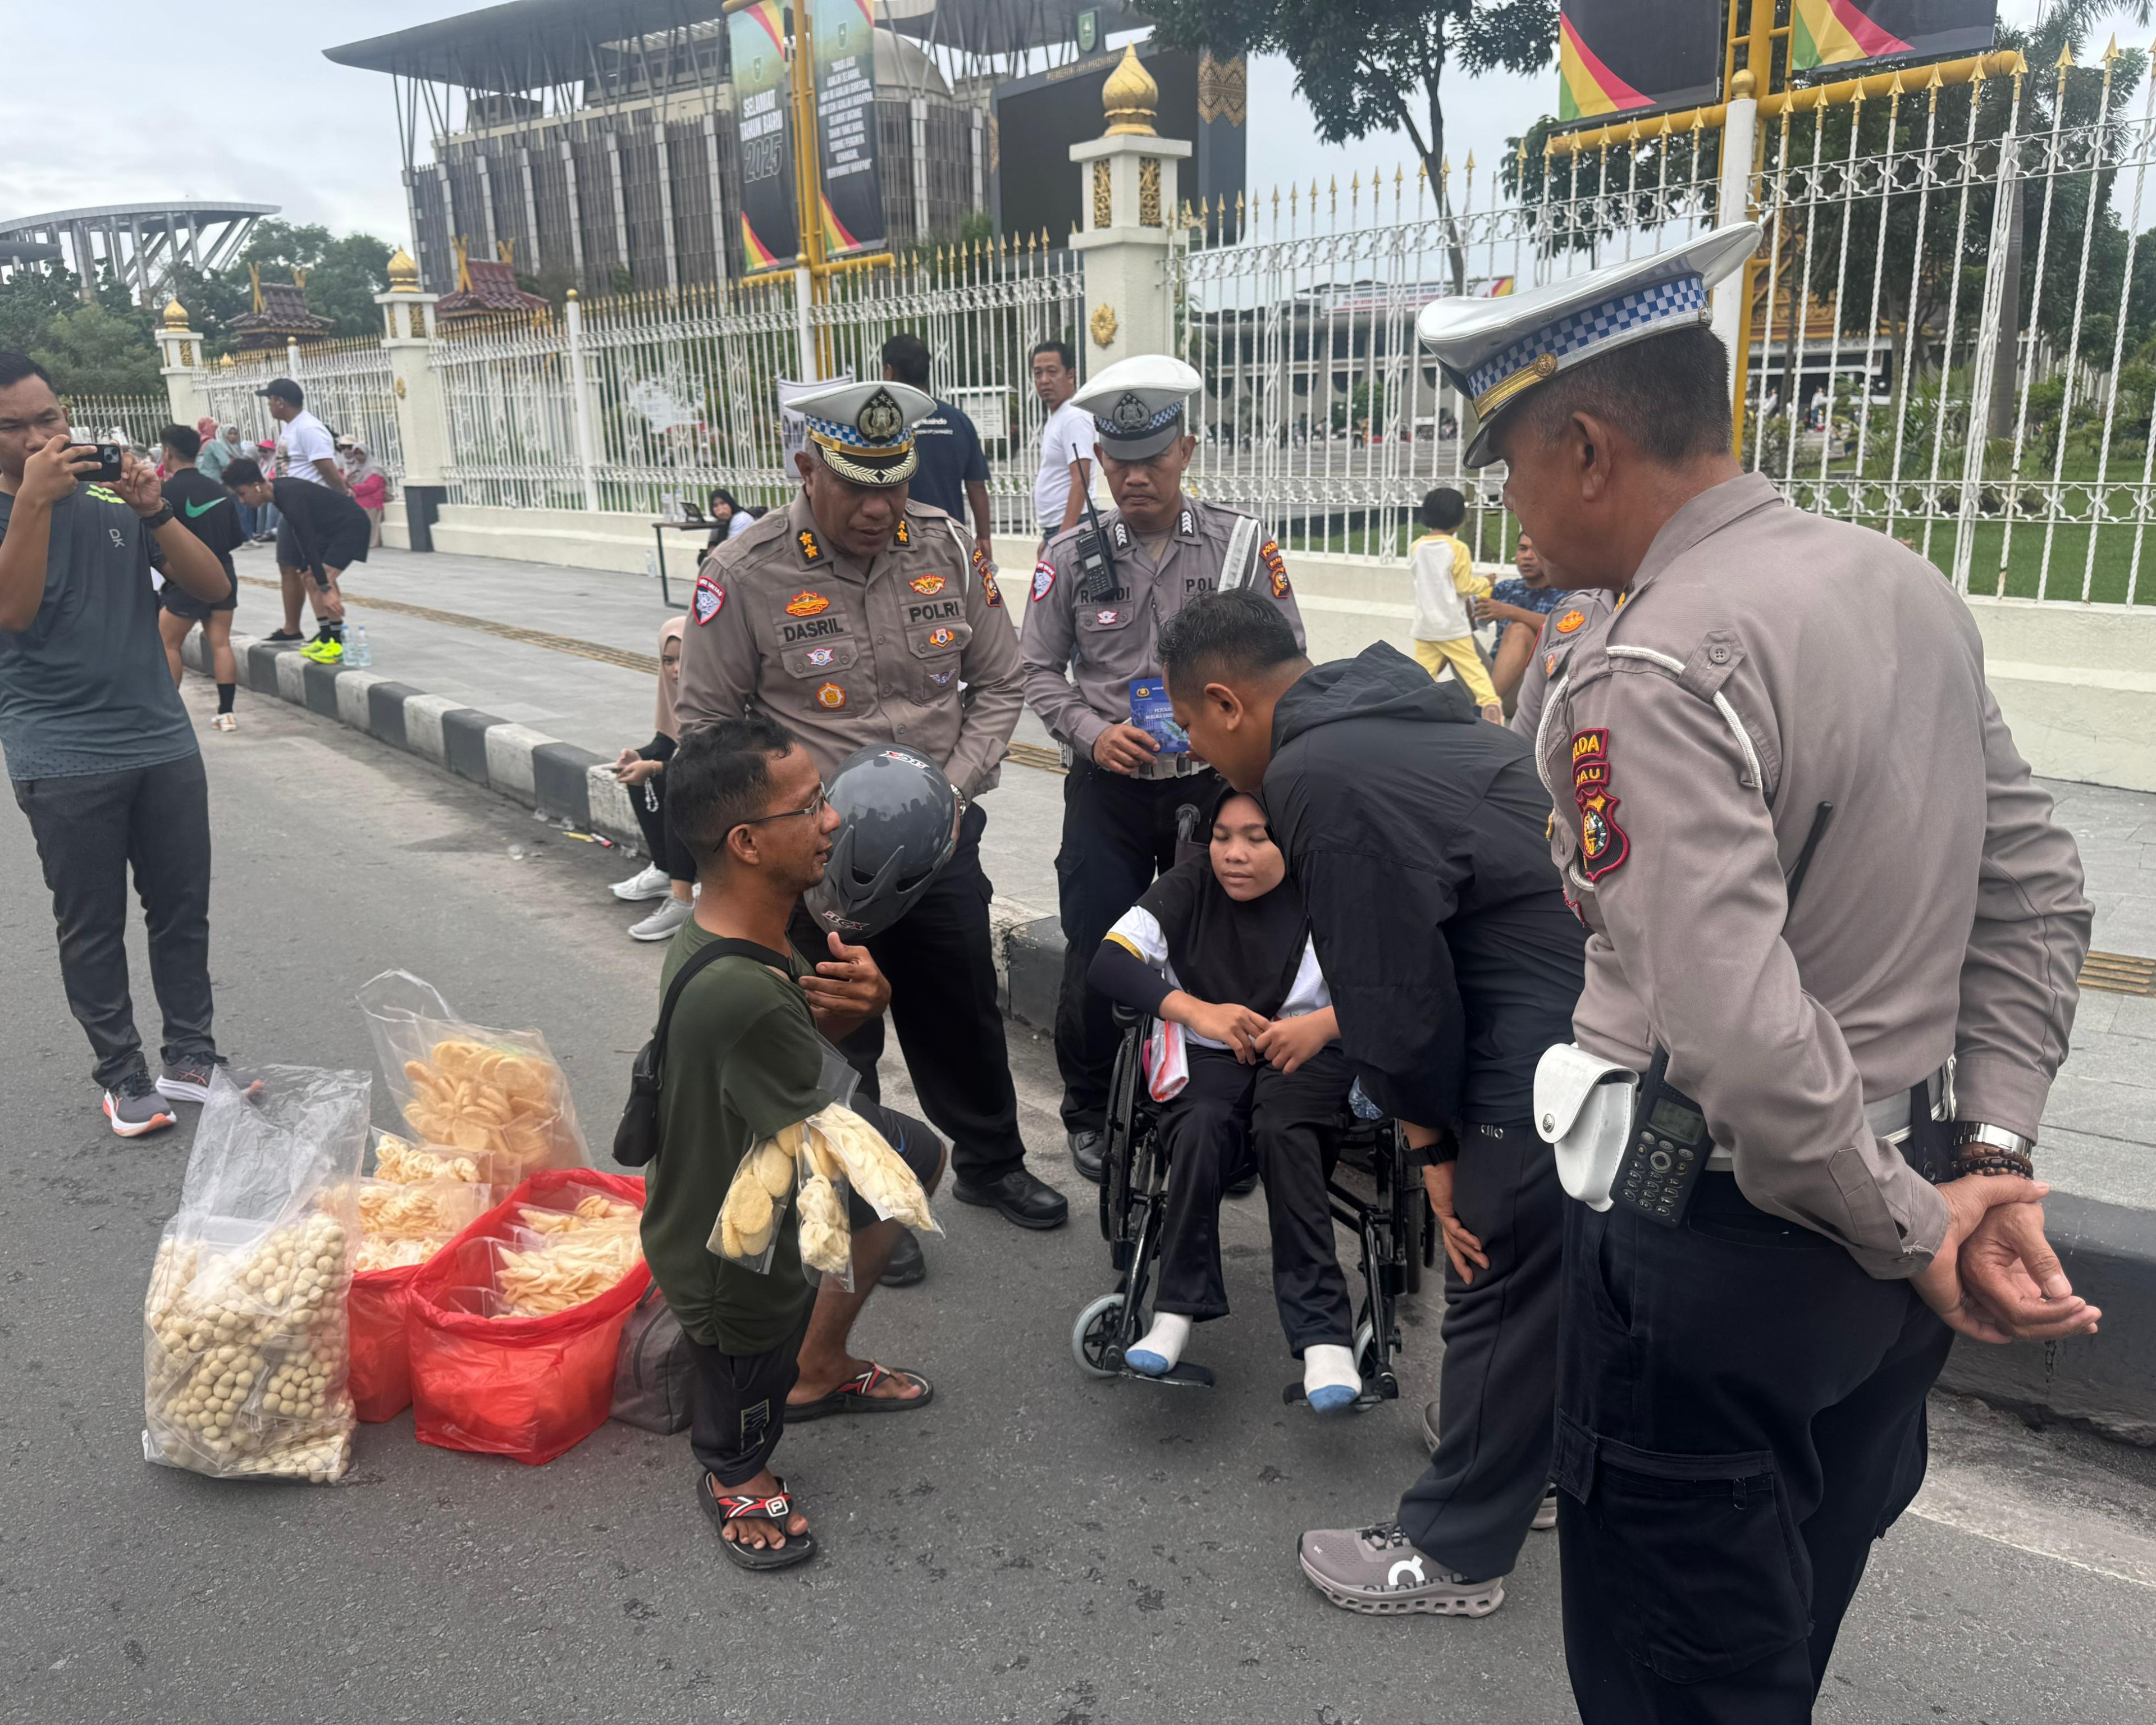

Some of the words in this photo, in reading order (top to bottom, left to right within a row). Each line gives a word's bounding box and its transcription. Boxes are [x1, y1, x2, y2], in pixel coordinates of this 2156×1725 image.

[743, 89, 776, 118] SELAMAT
[739, 116, 762, 142] TAHUN
[763, 109, 783, 135] BARU
[744, 133, 783, 183] 2025
[908, 601, 960, 623] POLRI
[783, 618, 844, 642] DASRIL
[1573, 734, 1600, 762] LDA
